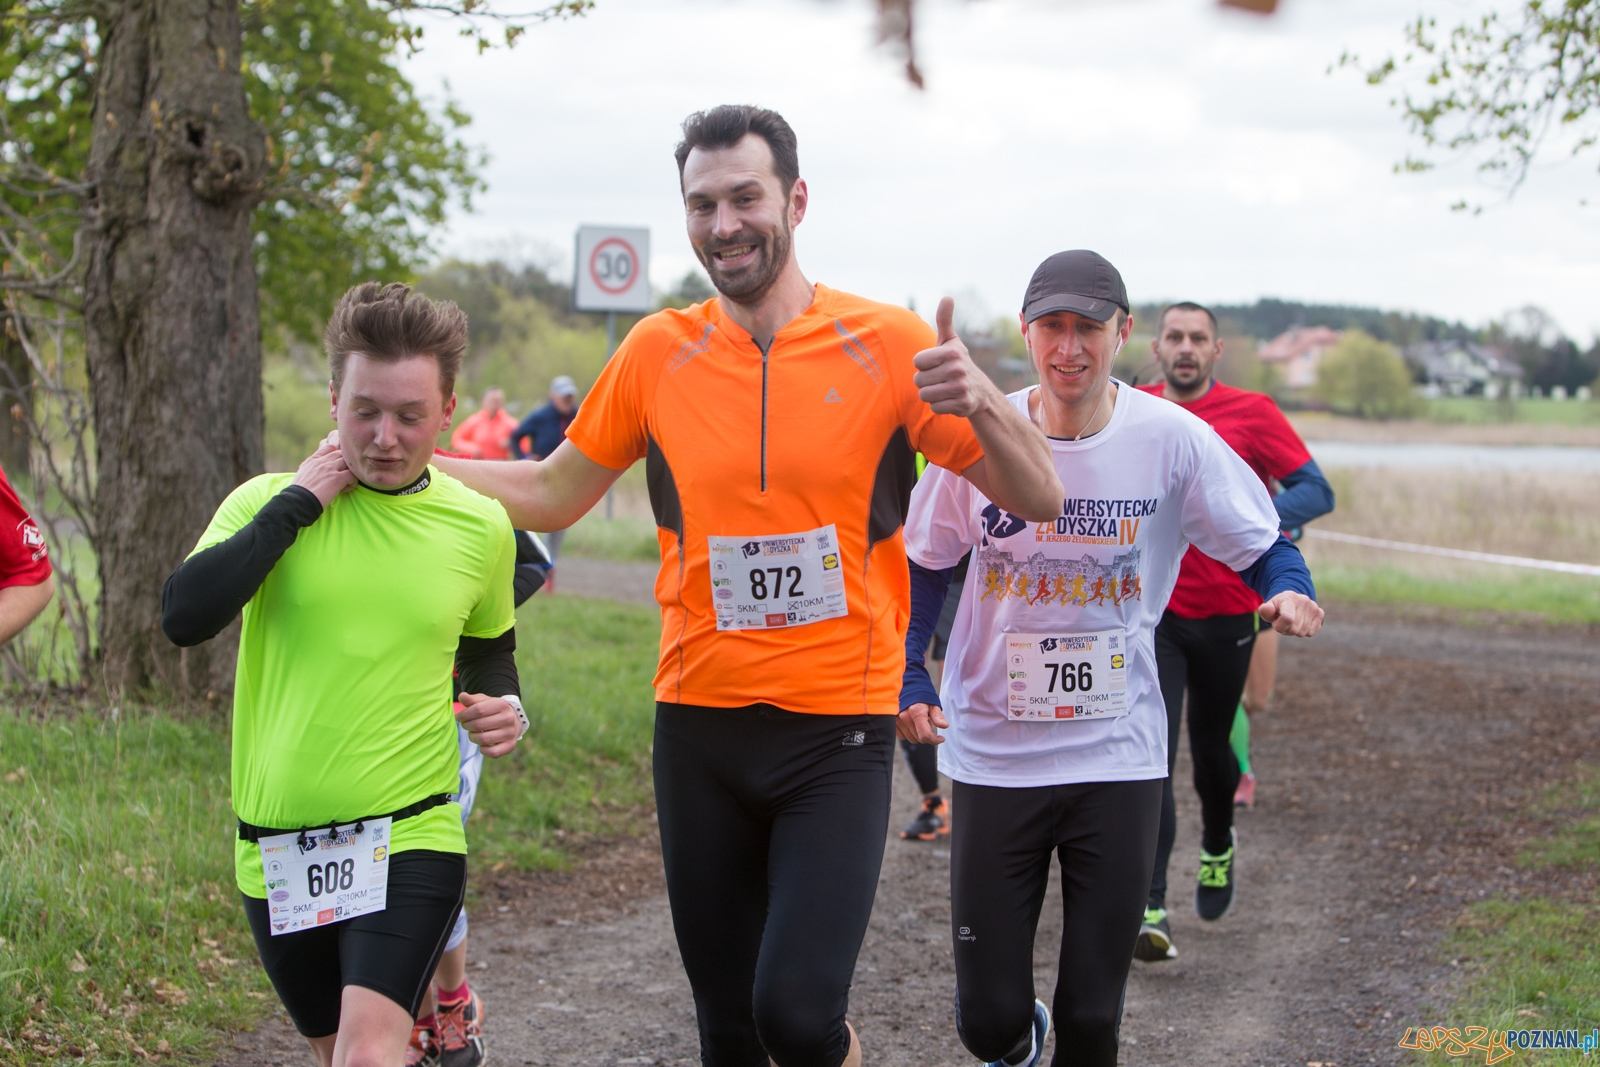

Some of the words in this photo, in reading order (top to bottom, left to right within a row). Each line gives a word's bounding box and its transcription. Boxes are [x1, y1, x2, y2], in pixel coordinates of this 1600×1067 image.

[599, 252, 631, 280] 30
[1063, 499, 1157, 517] WERSYTECKA
[1035, 517, 1118, 537] ZADYSZKA
[1119, 518, 1140, 546] IV
[1045, 535, 1071, 543] JERZEGO
[762, 536, 805, 548] UNIWERSYTECKA
[763, 544, 791, 555] ZADYSZKA
[749, 565, 804, 600] 872
[737, 604, 757, 613] 5KM
[799, 596, 824, 608] 10KM
[1060, 635, 1098, 643] UNIWERSYTECKA
[1060, 642, 1086, 650] ZADYSZKA
[1044, 661, 1093, 693] 766
[1029, 697, 1048, 705] 5KM
[1086, 693, 1109, 703] 10KM
[320, 836, 349, 848] ZADYSZKA
[307, 858, 355, 898] 608
[293, 903, 312, 914] 5KM
[347, 889, 368, 901] 10KM
